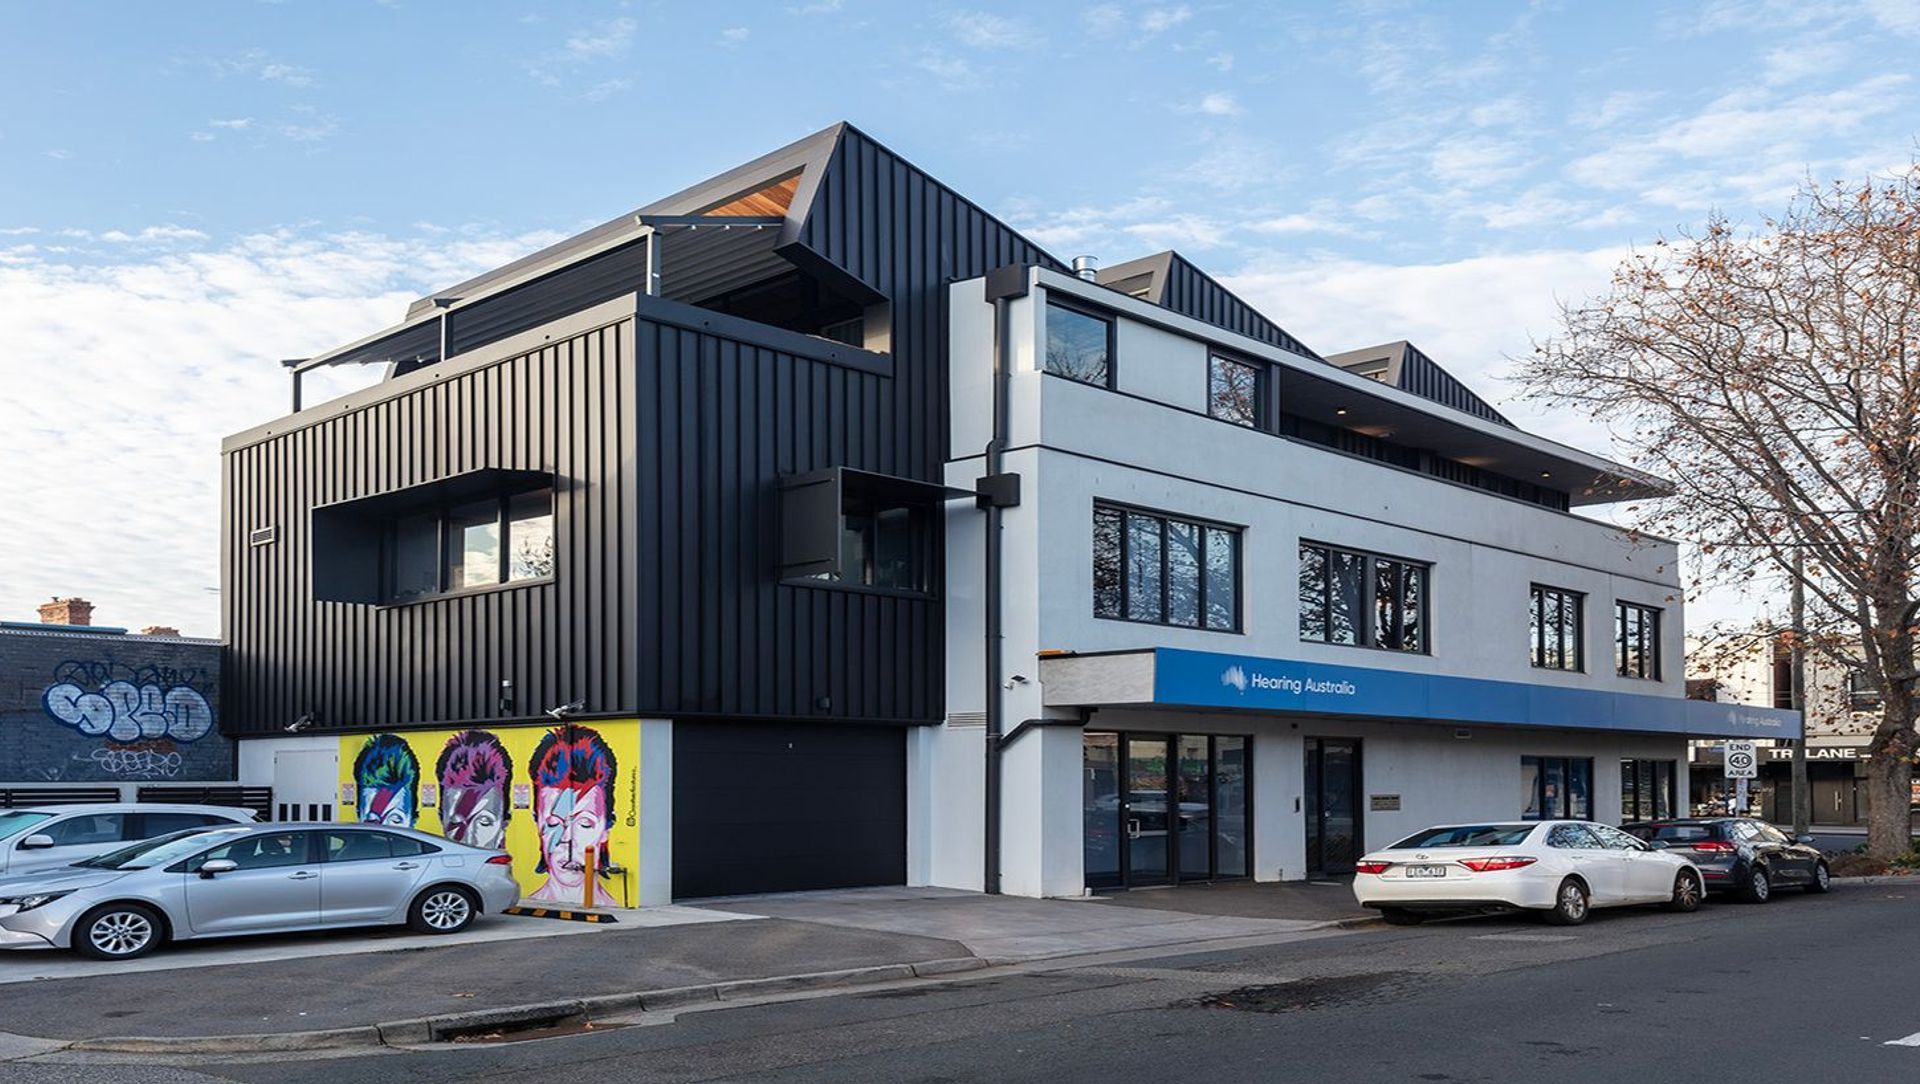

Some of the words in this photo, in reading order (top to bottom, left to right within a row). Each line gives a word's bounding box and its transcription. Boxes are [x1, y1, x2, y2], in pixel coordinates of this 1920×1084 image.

[1251, 673, 1302, 695] Hearing
[1304, 678, 1356, 695] Australia
[1729, 743, 1751, 751] END
[1732, 751, 1749, 764] 40
